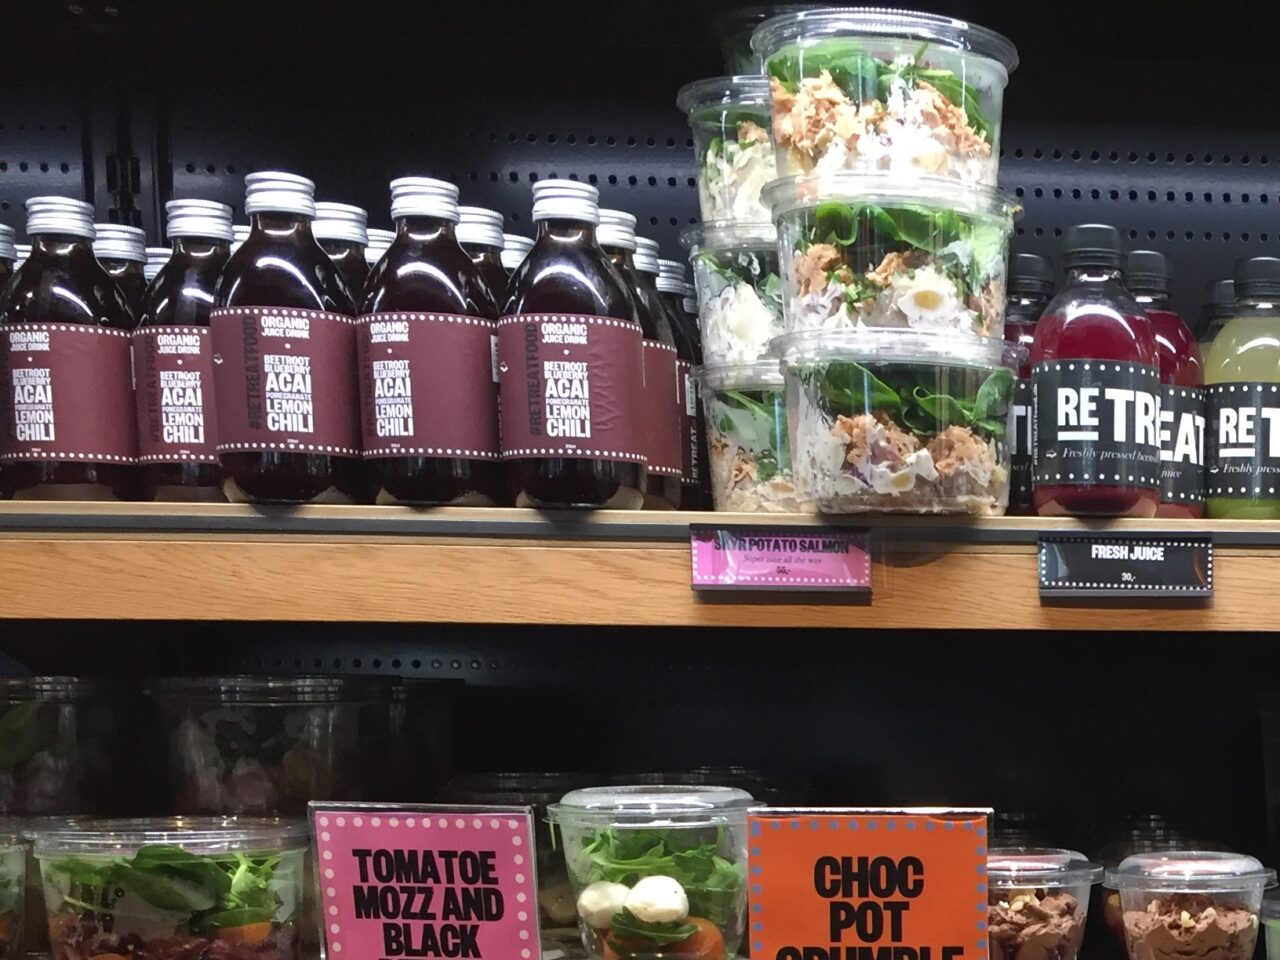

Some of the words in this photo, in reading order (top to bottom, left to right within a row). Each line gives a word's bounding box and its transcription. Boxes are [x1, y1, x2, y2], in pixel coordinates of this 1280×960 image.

[261, 315, 310, 329] ORGANIC
[370, 321, 409, 334] ORGANIC
[541, 322, 588, 335] ORGANIC
[9, 331, 50, 343] ORGANIC
[157, 334, 200, 346] ORGANIC
[261, 327, 285, 337] JUICE
[285, 329, 310, 339] DRINK
[371, 333, 387, 343] JUICE
[541, 334, 564, 344] JUICE
[564, 335, 588, 345] DRINK
[263, 354, 310, 366] BEETROOT
[373, 360, 410, 371] BEETROOT
[544, 361, 588, 372] BEETROOT
[264, 364, 310, 374] BLUEBERRY
[544, 370, 588, 380] BLUEBERRY
[265, 372, 312, 394] ACAI
[375, 378, 411, 397] ACAI
[545, 379, 589, 398] ACAI
[14, 385, 52, 403] ACAI
[161, 388, 202, 406] ACAI
[266, 399, 313, 415] LEMON
[376, 404, 413, 418] LEMON
[546, 405, 590, 420] LEMON
[15, 410, 54, 424] LEMON
[162, 412, 204, 426] LEMON
[267, 413, 314, 433] CHILI
[16, 424, 55, 441] CHILI
[163, 426, 205, 444] CHILI
[376, 418, 414, 437] CHILI
[546, 419, 591, 438] CHILI
[1062, 448, 1098, 459] Freshly
[1100, 450, 1136, 461] pressed
[749, 538, 796, 552] POTATO
[799, 539, 849, 554] SALMON
[1091, 544, 1128, 560] FRESH
[1130, 545, 1164, 561] JUICE
[1121, 572, 1136, 582] 30,-
[352, 848, 499, 886] TOMATOE
[814, 856, 924, 898] CHOC
[352, 885, 436, 920] MOZZ
[441, 887, 505, 922] AND
[829, 901, 909, 943] POT
[382, 923, 482, 959] BLACK
